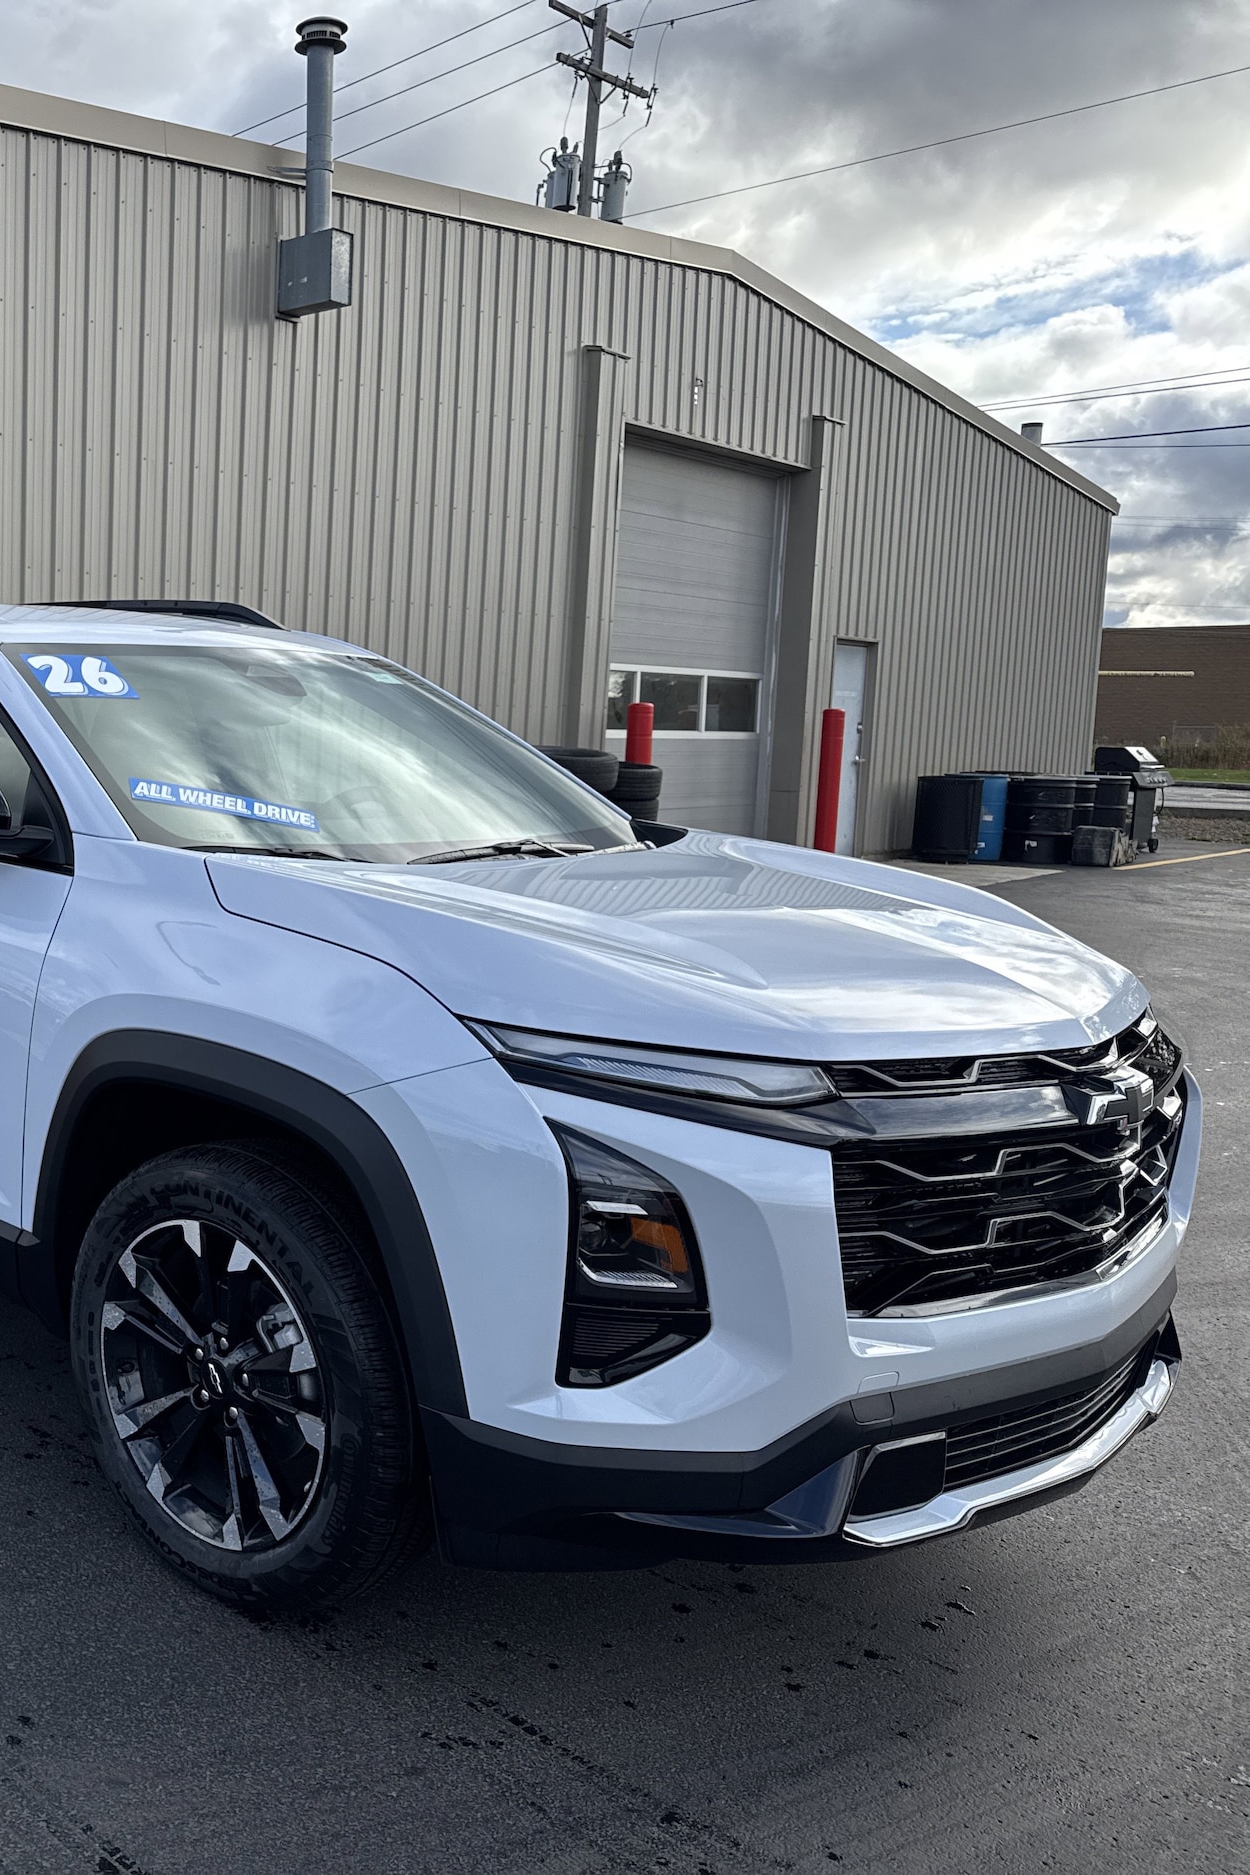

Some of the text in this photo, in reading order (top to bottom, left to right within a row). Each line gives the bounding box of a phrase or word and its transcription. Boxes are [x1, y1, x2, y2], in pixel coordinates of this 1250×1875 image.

[27, 656, 128, 694] 26
[133, 781, 315, 828] ALL WHEEL DRIVE
